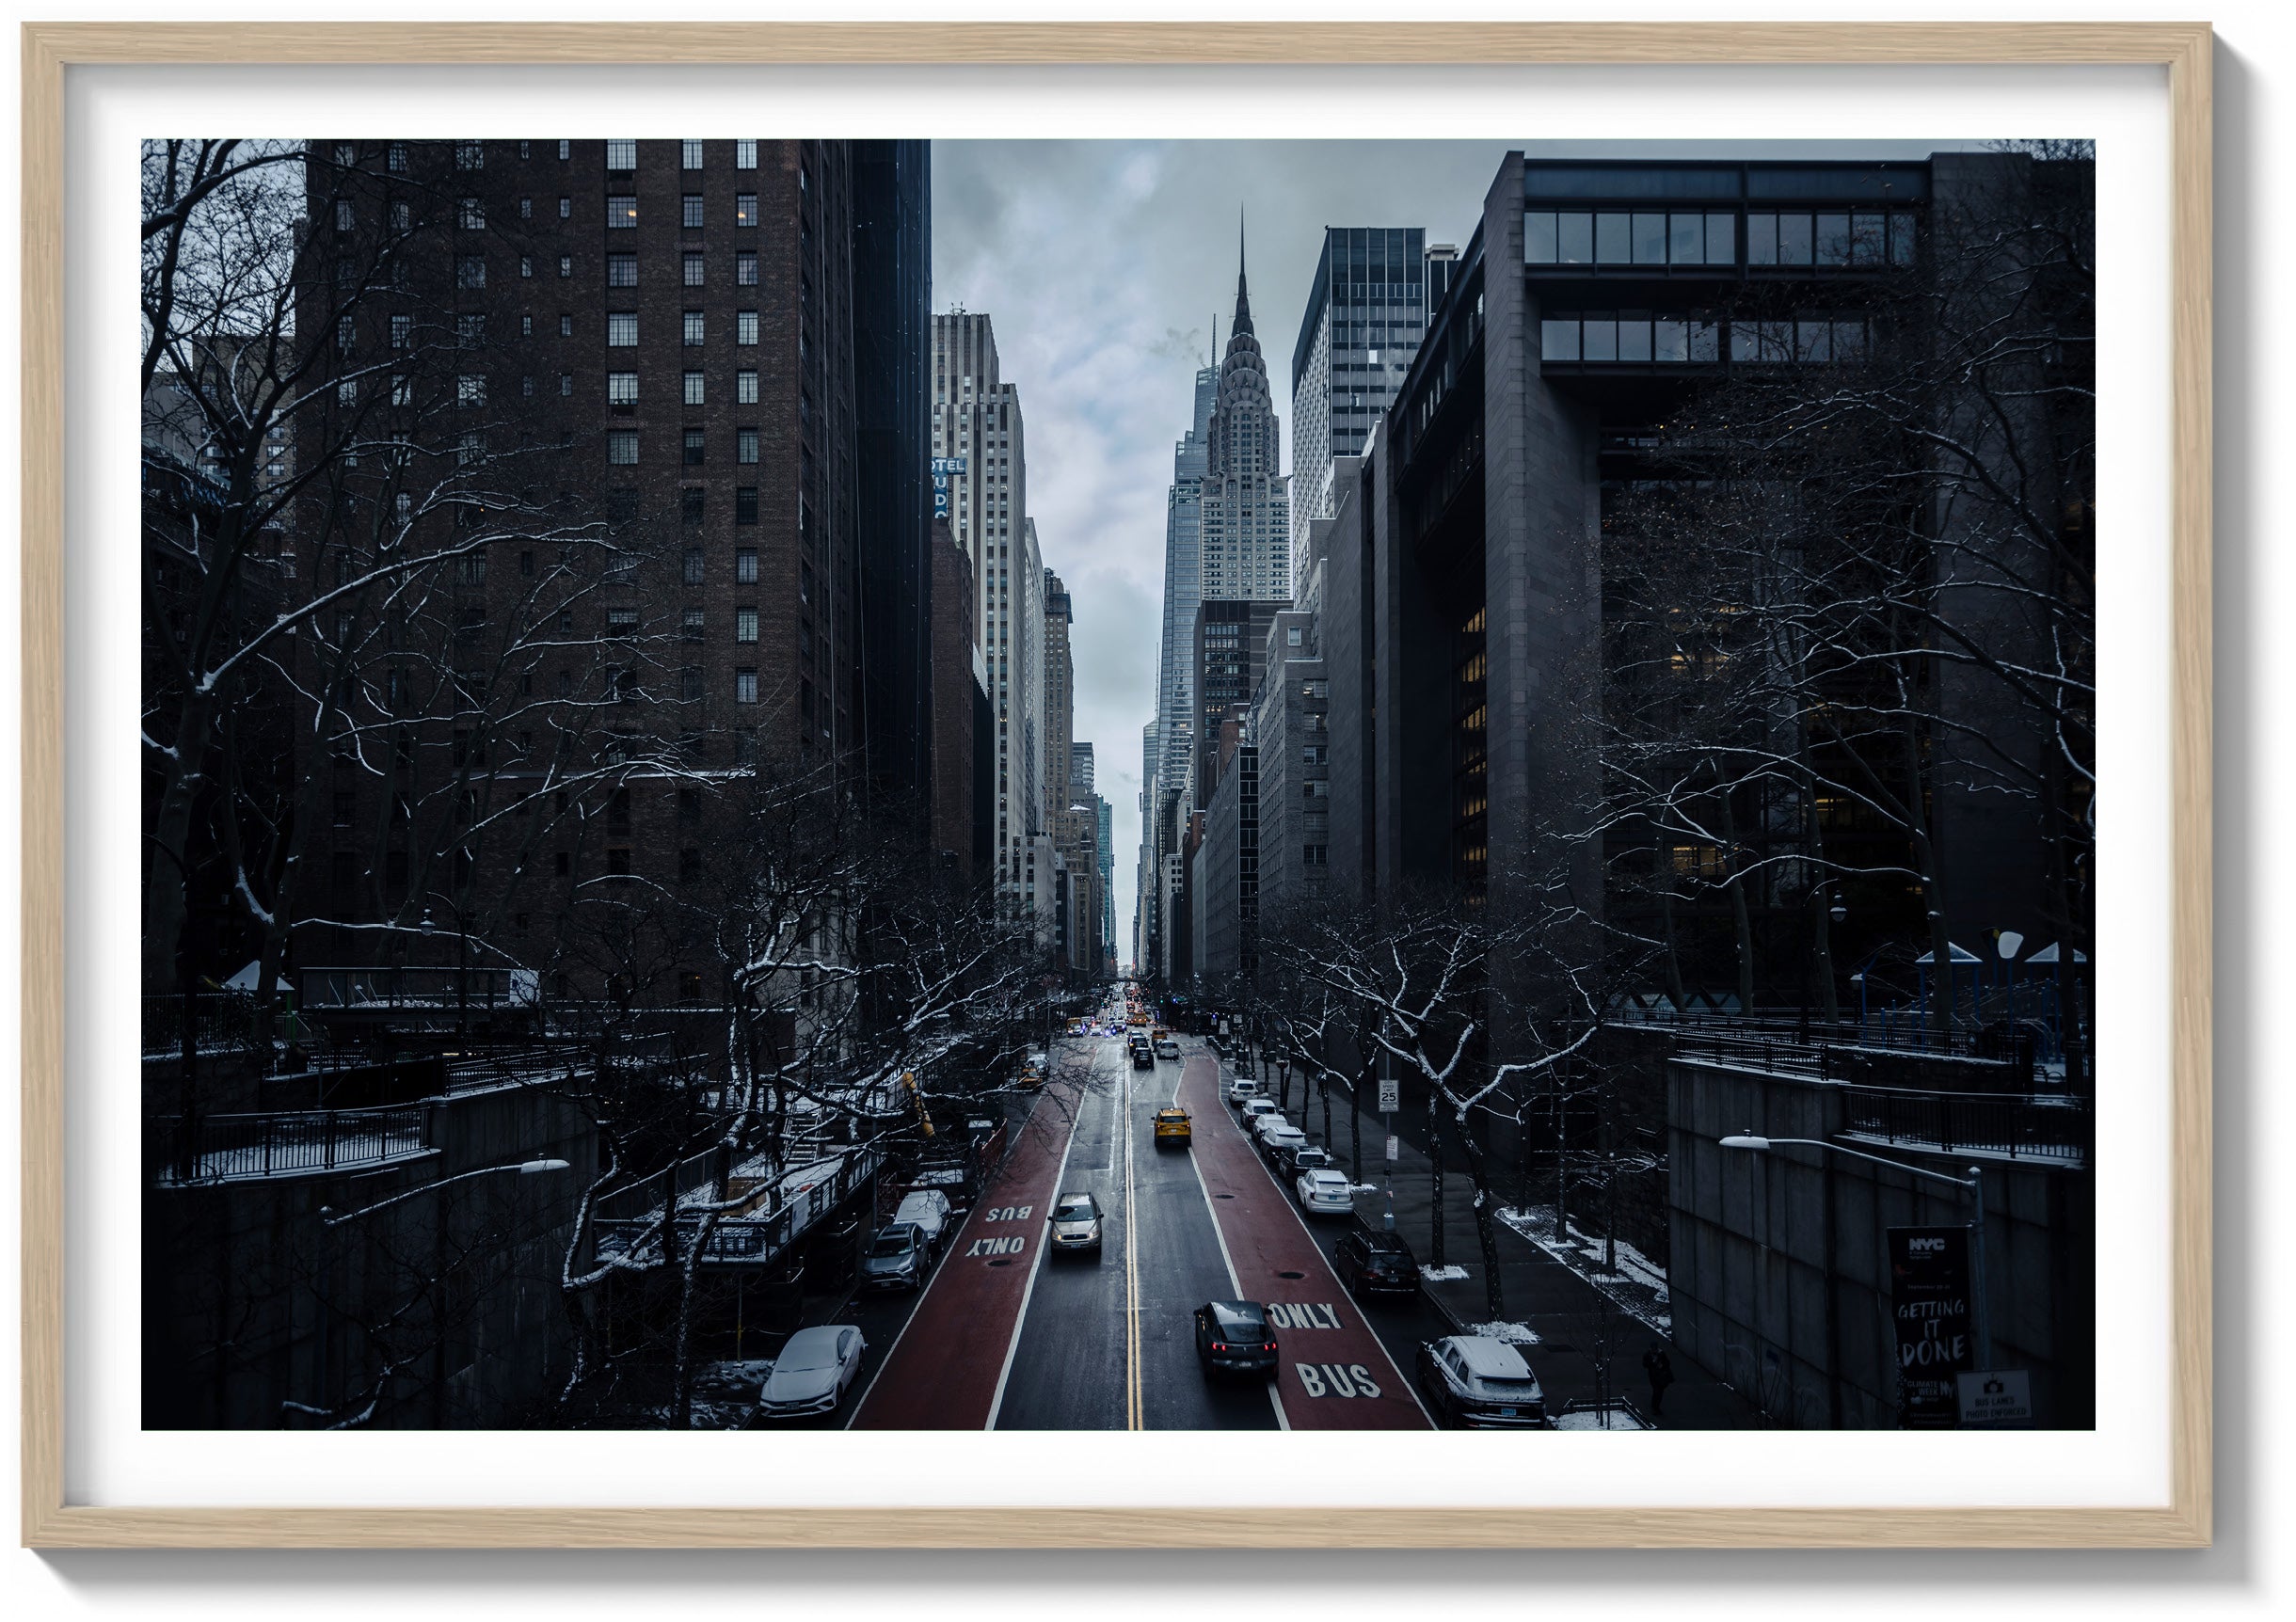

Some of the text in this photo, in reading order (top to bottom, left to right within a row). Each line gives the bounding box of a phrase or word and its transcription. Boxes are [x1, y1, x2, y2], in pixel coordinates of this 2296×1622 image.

[932, 459, 965, 471] TEL
[1381, 1092, 1396, 1102] 25
[984, 1205, 1033, 1222] BUS
[965, 1236, 1026, 1257] ONLY
[1908, 1237, 1945, 1250] NYC
[1268, 1303, 1342, 1328] ONLY
[1897, 1298, 1966, 1318] GETTING
[1923, 1318, 1941, 1339] IT
[1902, 1333, 1966, 1368] DONE
[1295, 1362, 1381, 1398] BUS
[1939, 1379, 1954, 1400] NY
[1974, 1396, 2015, 1407] BUS LANES
[1965, 1410, 1988, 1420] PHOTO
[1990, 1407, 2027, 1418] ENFORCED
